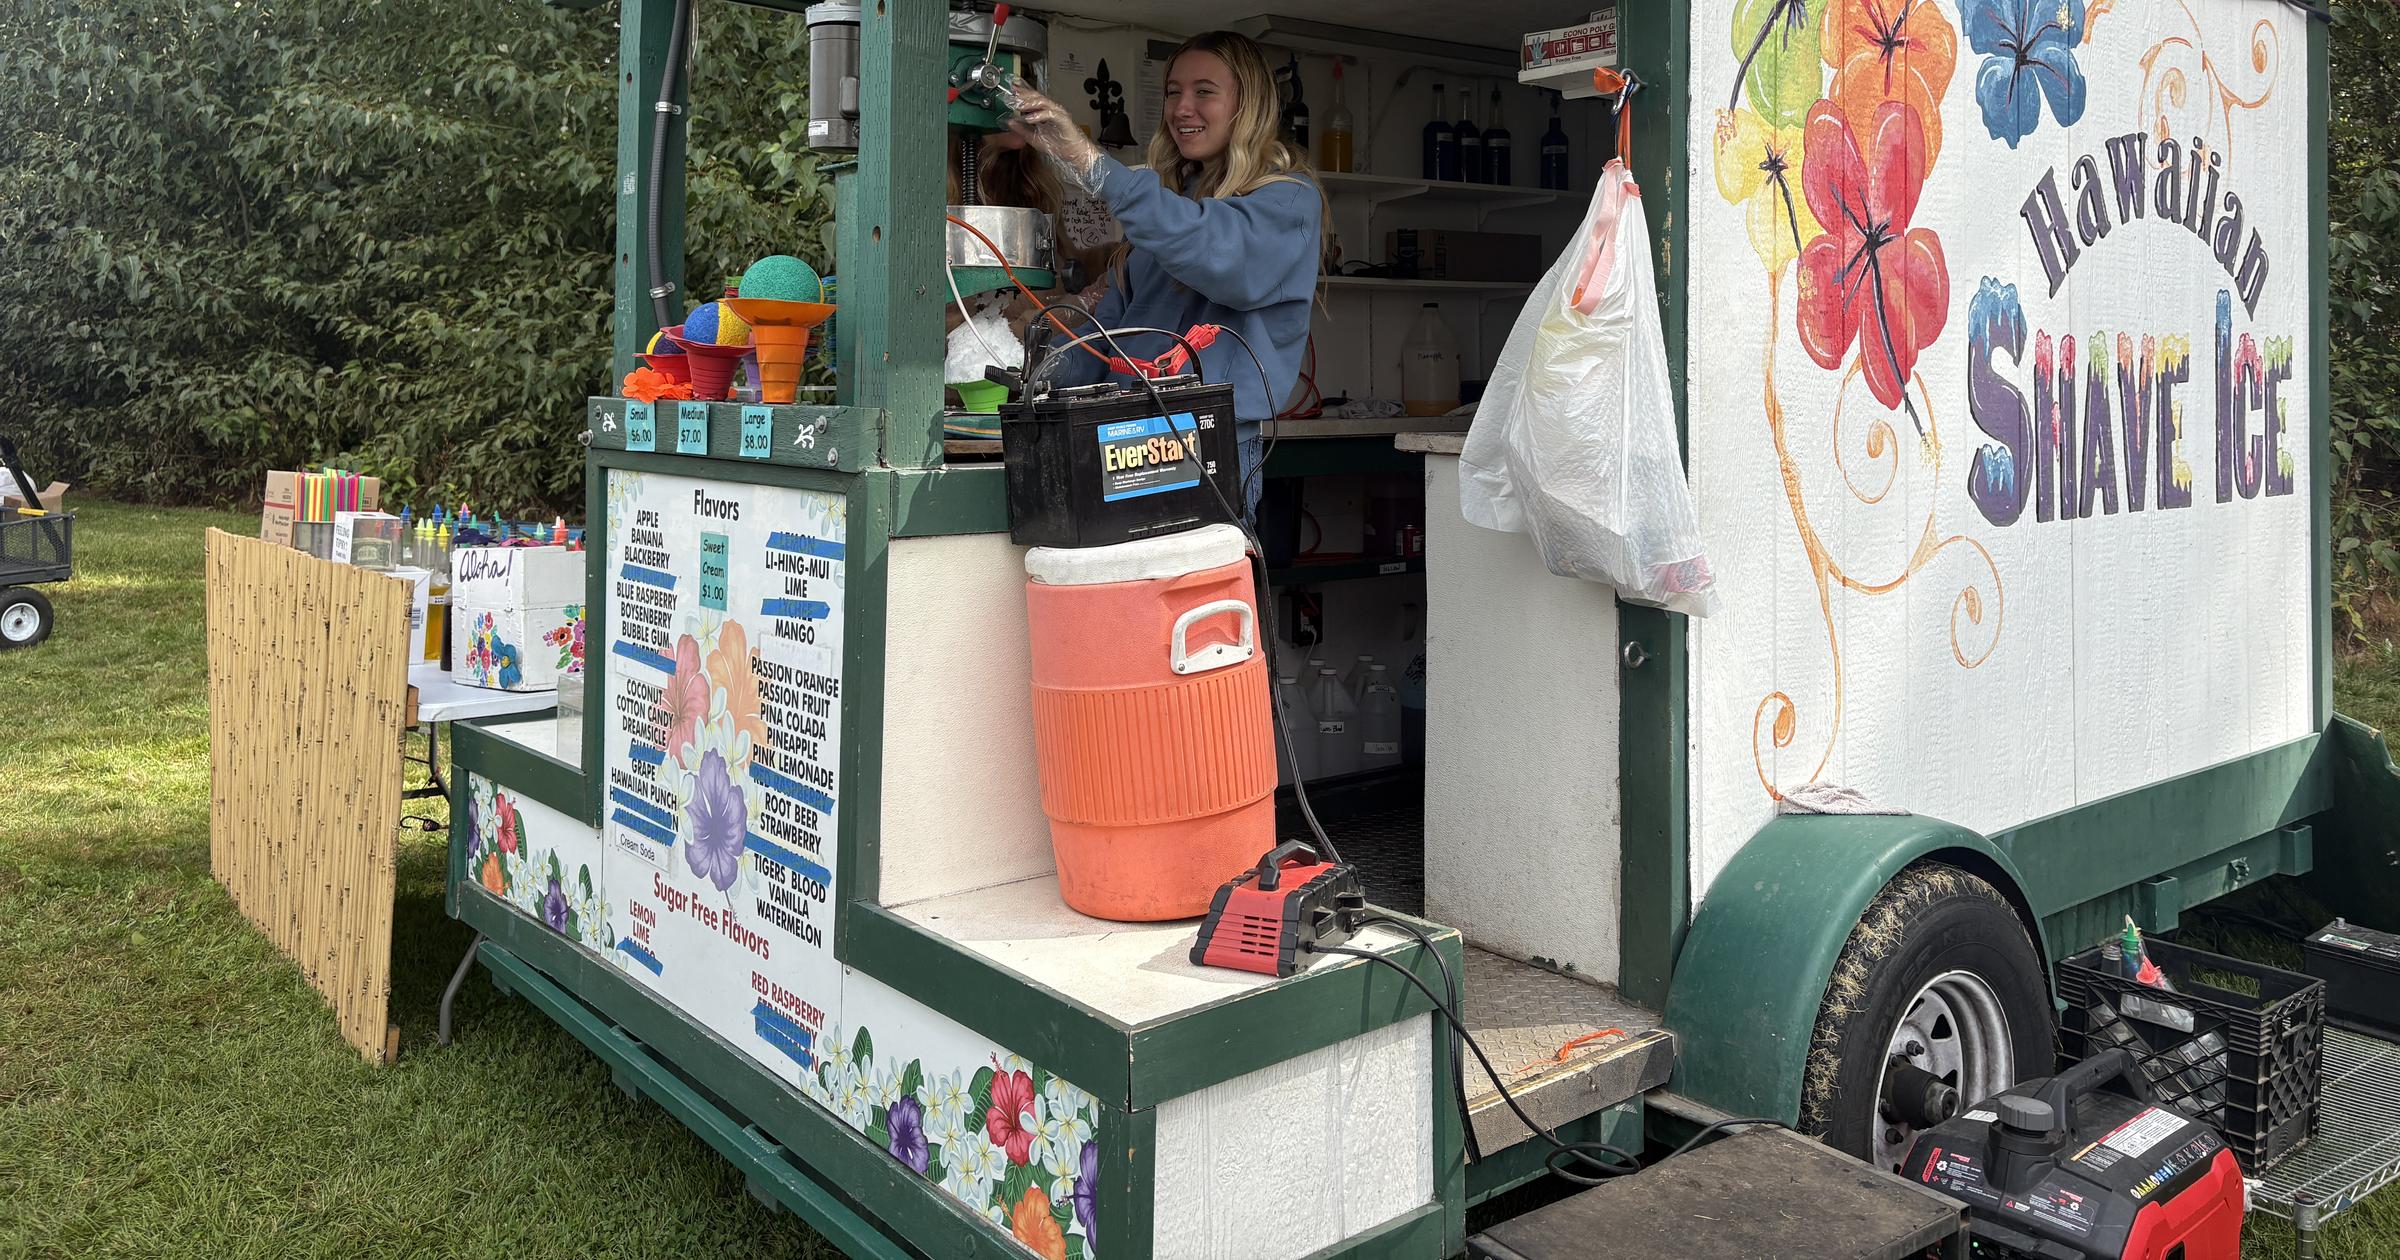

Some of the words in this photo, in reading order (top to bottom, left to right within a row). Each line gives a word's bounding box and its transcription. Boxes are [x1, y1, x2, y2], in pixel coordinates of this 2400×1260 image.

[1563, 28, 1588, 38] ECONO
[1590, 24, 1608, 34] POLY
[2020, 132, 2269, 321] Hawaiian
[629, 407, 648, 421] Small
[681, 406, 706, 421] Medium
[1967, 275, 2192, 527] SHAVE
[744, 410, 766, 429] Large
[1199, 418, 1215, 430] 27DC
[631, 428, 652, 442] $6.00
[680, 429, 702, 445] $7.00
[744, 434, 768, 450] $8.00
[1104, 431, 1198, 473] EverStart
[636, 509, 659, 529] APPLE
[694, 488, 740, 521] Flavors
[631, 527, 664, 549] BANANA
[703, 538, 725, 555] Sweet
[459, 549, 514, 587] Aloha!
[624, 545, 671, 570] BLACKBERRY
[702, 561, 725, 578] Cream
[765, 550, 830, 580] LI-HING-MUI
[616, 581, 634, 600] BLUE
[635, 585, 678, 611] RASPBERRY
[702, 583, 724, 601] $1.00
[784, 575, 808, 598] LIME
[620, 601, 673, 630] BOYSENBERRY
[621, 620, 649, 643] BUBBLE
[651, 628, 670, 649] GUM
[775, 618, 815, 645] MANGO
[626, 678, 663, 706] COCONUT
[751, 656, 793, 685] PASSION
[795, 669, 839, 698] ORANGE
[616, 694, 646, 719] COTTON
[647, 705, 674, 729] CANDY
[758, 679, 799, 710] PASSION
[802, 692, 831, 719] FRUIT
[622, 714, 666, 747] DREAMSICLE
[760, 702, 784, 727] PINA
[786, 710, 827, 741] COLADA
[767, 726, 818, 761] PINEAPPLE
[631, 757, 656, 782] GRAPE
[752, 743, 776, 769] PINK
[778, 752, 834, 791] LEMONADE
[611, 766, 649, 799] HAWAIIAN
[650, 783, 678, 812] PUNCH
[765, 792, 792, 820] ROOT
[794, 803, 818, 832] BEER
[619, 833, 639, 854] Cream
[639, 843, 655, 862] Soda
[760, 812, 822, 855] STRAWBERRY
[753, 852, 786, 885] TIGERS
[791, 870, 826, 904] BLOOD
[629, 898, 656, 929] LEMON
[768, 881, 810, 920] VANILLA
[653, 871, 689, 913] Sugar
[691, 892, 718, 931] Free
[722, 908, 770, 961] Flavors
[756, 896, 822, 949] WATERMELON
[632, 919, 650, 945] LIME
[751, 970, 769, 996] RED
[771, 982, 826, 1031] RASPBERRY
